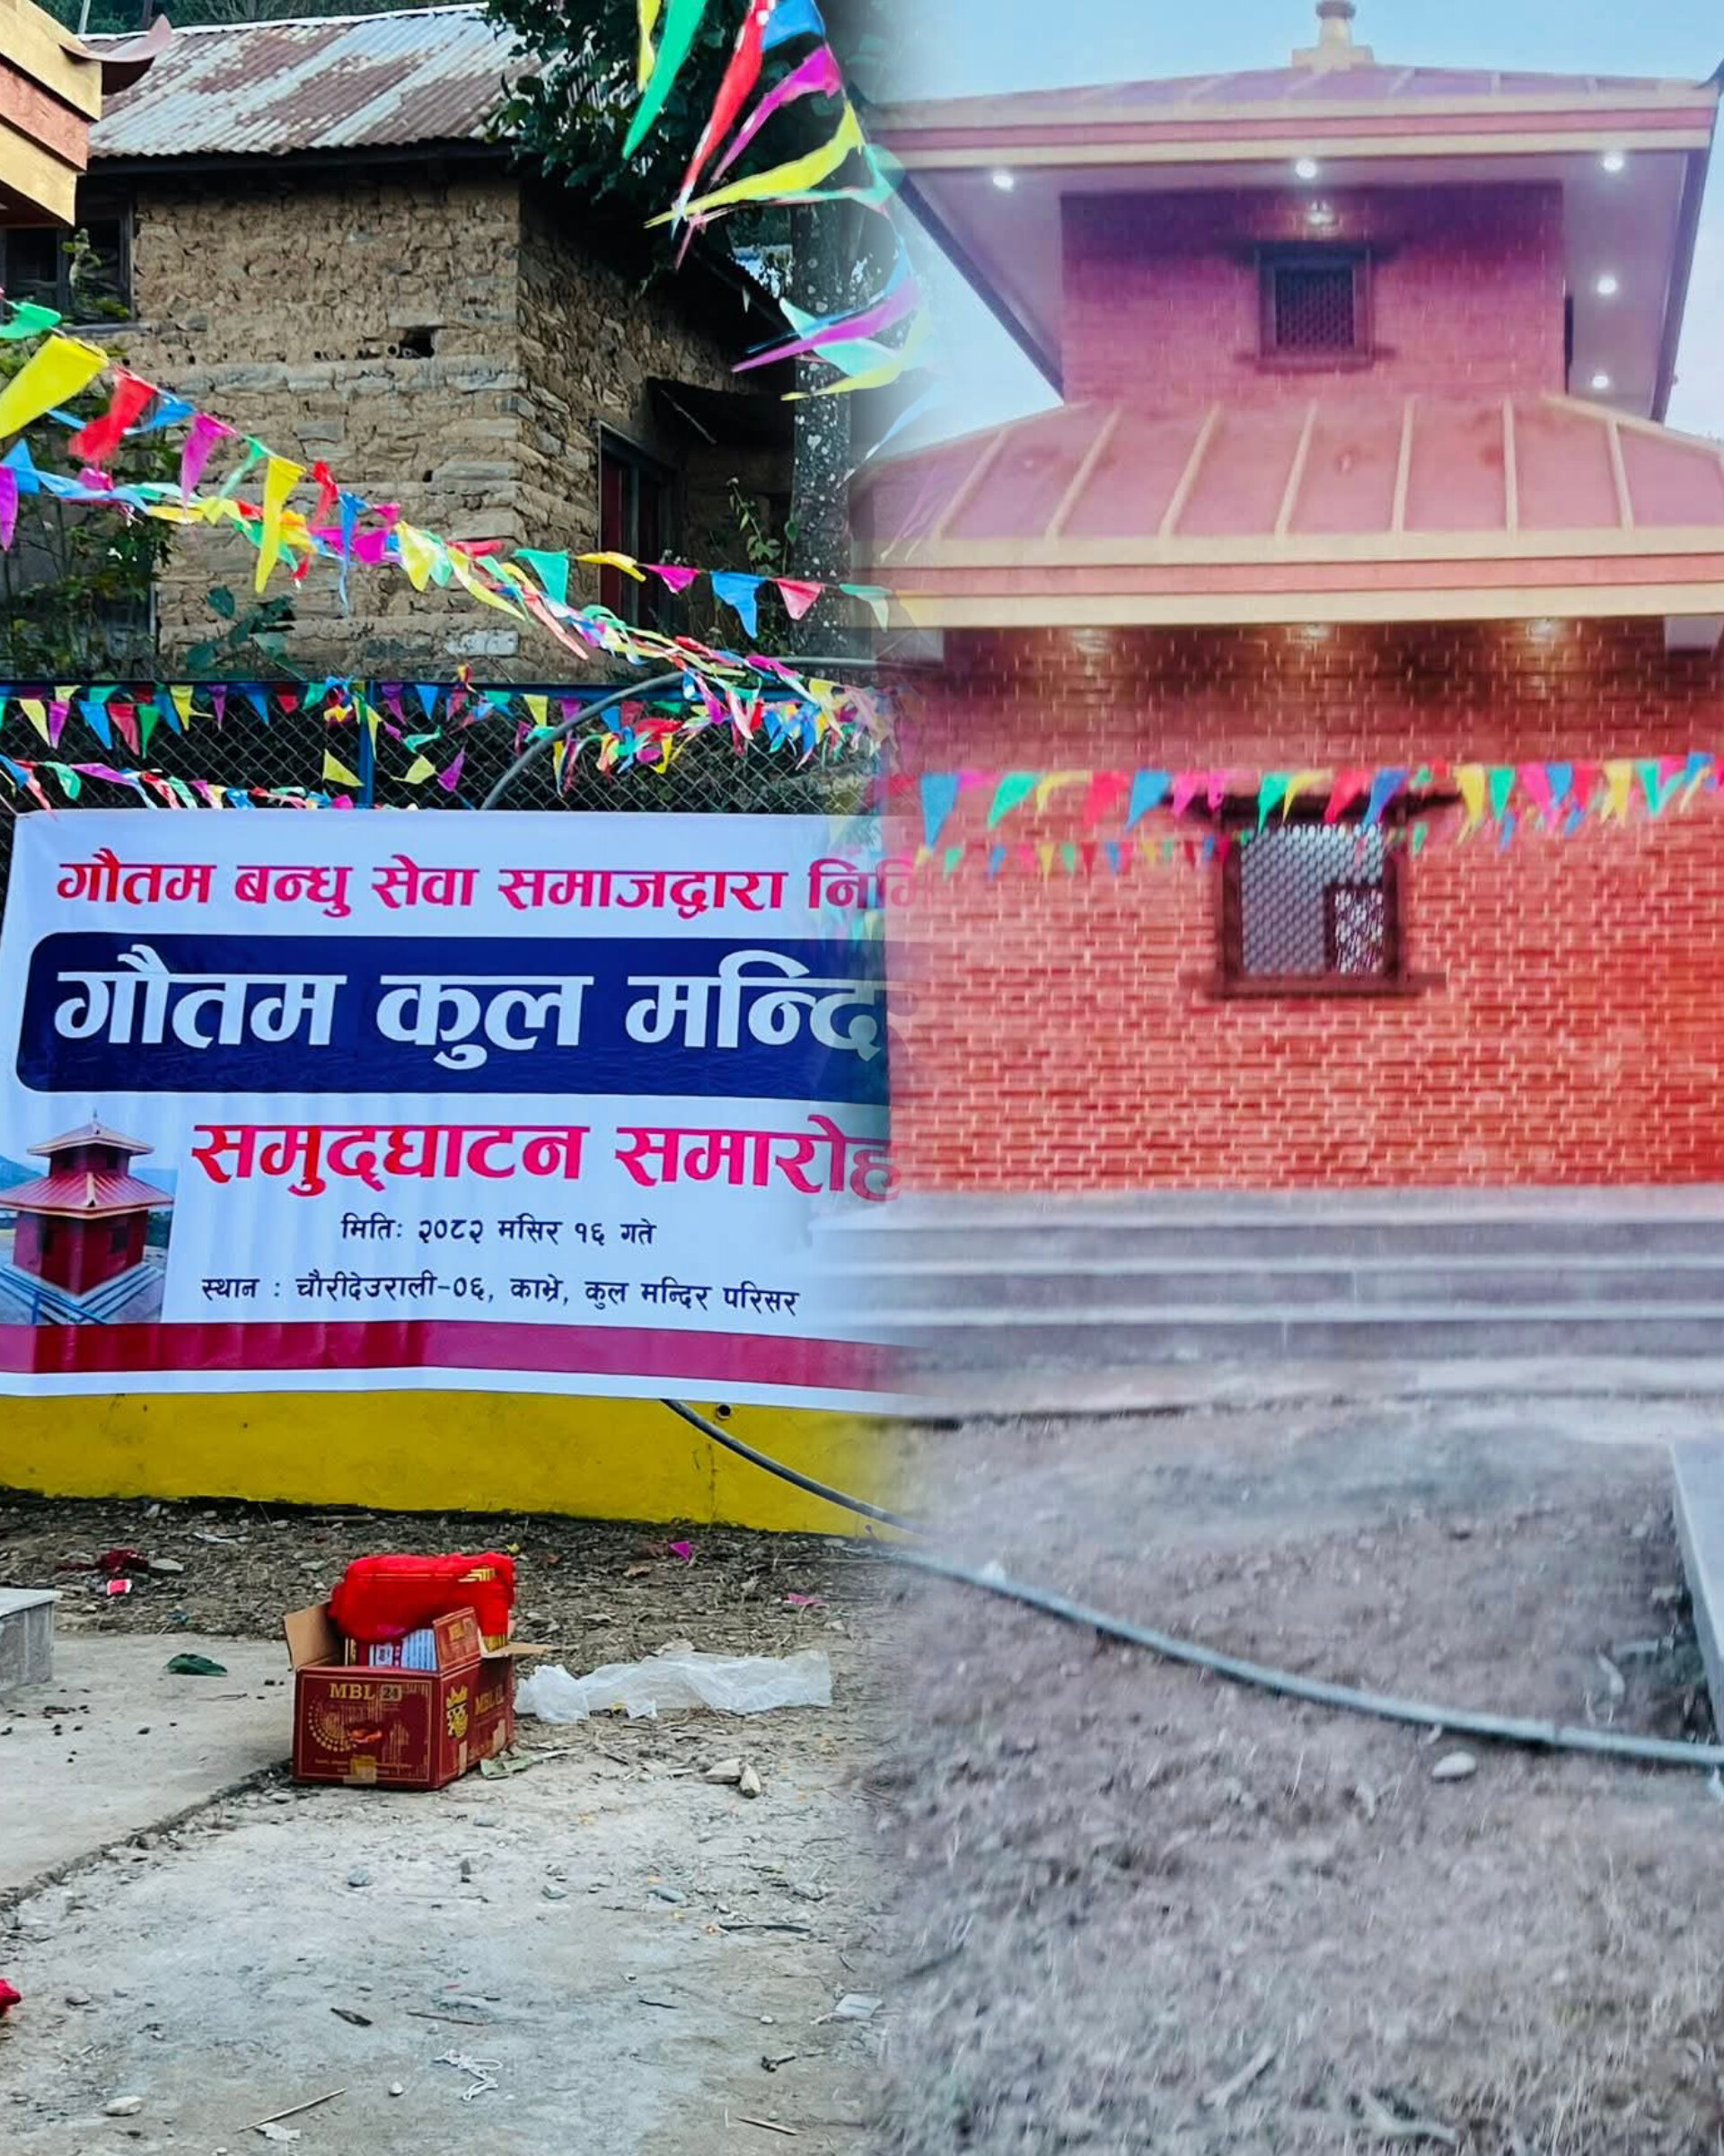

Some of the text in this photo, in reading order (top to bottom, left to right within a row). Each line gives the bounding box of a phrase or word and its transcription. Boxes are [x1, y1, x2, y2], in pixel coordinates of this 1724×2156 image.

[56, 848, 218, 905] गौतम
[234, 866, 354, 918] बन्धु
[371, 854, 480, 909] सेवा
[497, 868, 789, 920] समाजद्वारा
[54, 944, 347, 1048] गौतम
[376, 975, 594, 1069] कुल
[614, 1113, 901, 1201] समारोह
[418, 1219, 484, 1245] २०८२
[575, 1222, 605, 1245] १६
[620, 1219, 657, 1245] गते
[202, 1278, 260, 1301] स्थान
[584, 1281, 630, 1311] कुल
[640, 1276, 713, 1311] मन्दिर
[723, 1280, 800, 1316] परिसर
[330, 1683, 376, 1700] MBL
